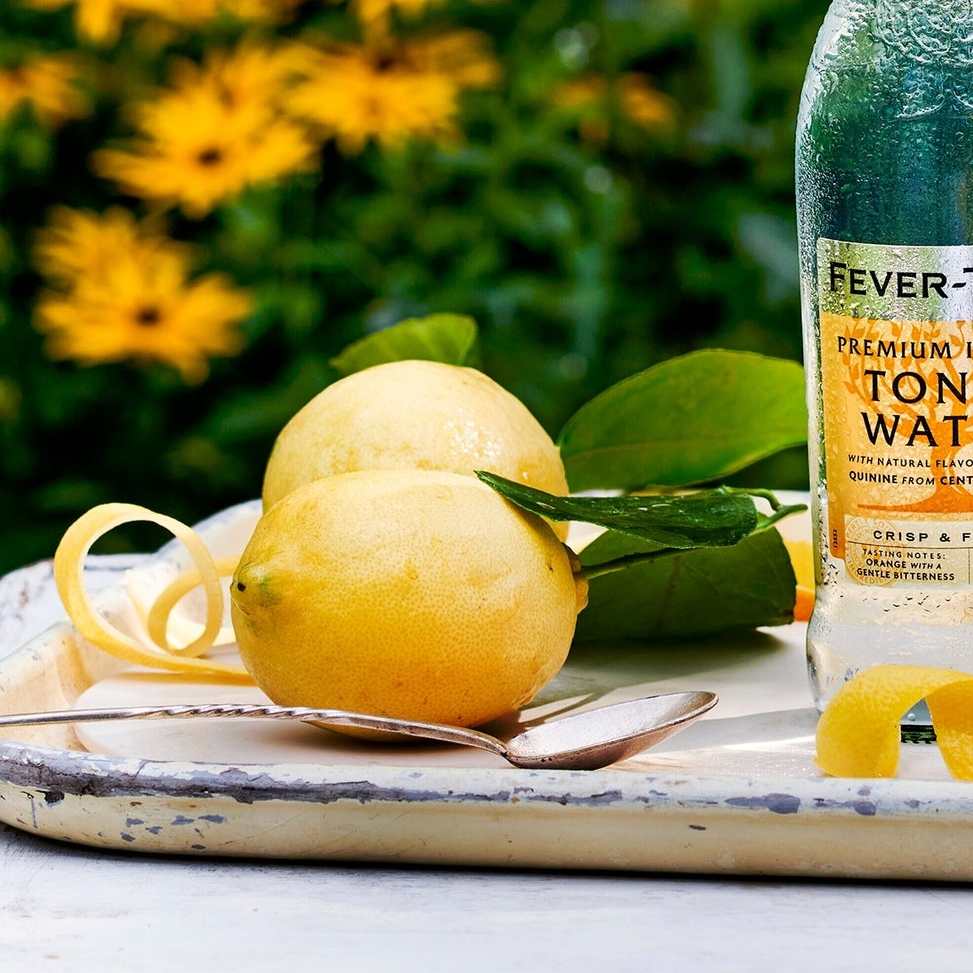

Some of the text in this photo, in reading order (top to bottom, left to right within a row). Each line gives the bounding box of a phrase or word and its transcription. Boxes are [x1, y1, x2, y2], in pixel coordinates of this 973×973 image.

[837, 335, 951, 360] PREMIUM
[848, 454, 873, 466] WITH
[877, 457, 931, 468] NATURAL
[848, 470, 898, 484] QUININE
[901, 476, 935, 486] FROM
[873, 529, 929, 542] CRISP
[939, 532, 951, 542] &
[862, 548, 946, 560] TASTING NOTES:
[865, 558, 942, 570] ORANGE WITH A
[856, 567, 955, 581] GENTLE BITTERNESS
